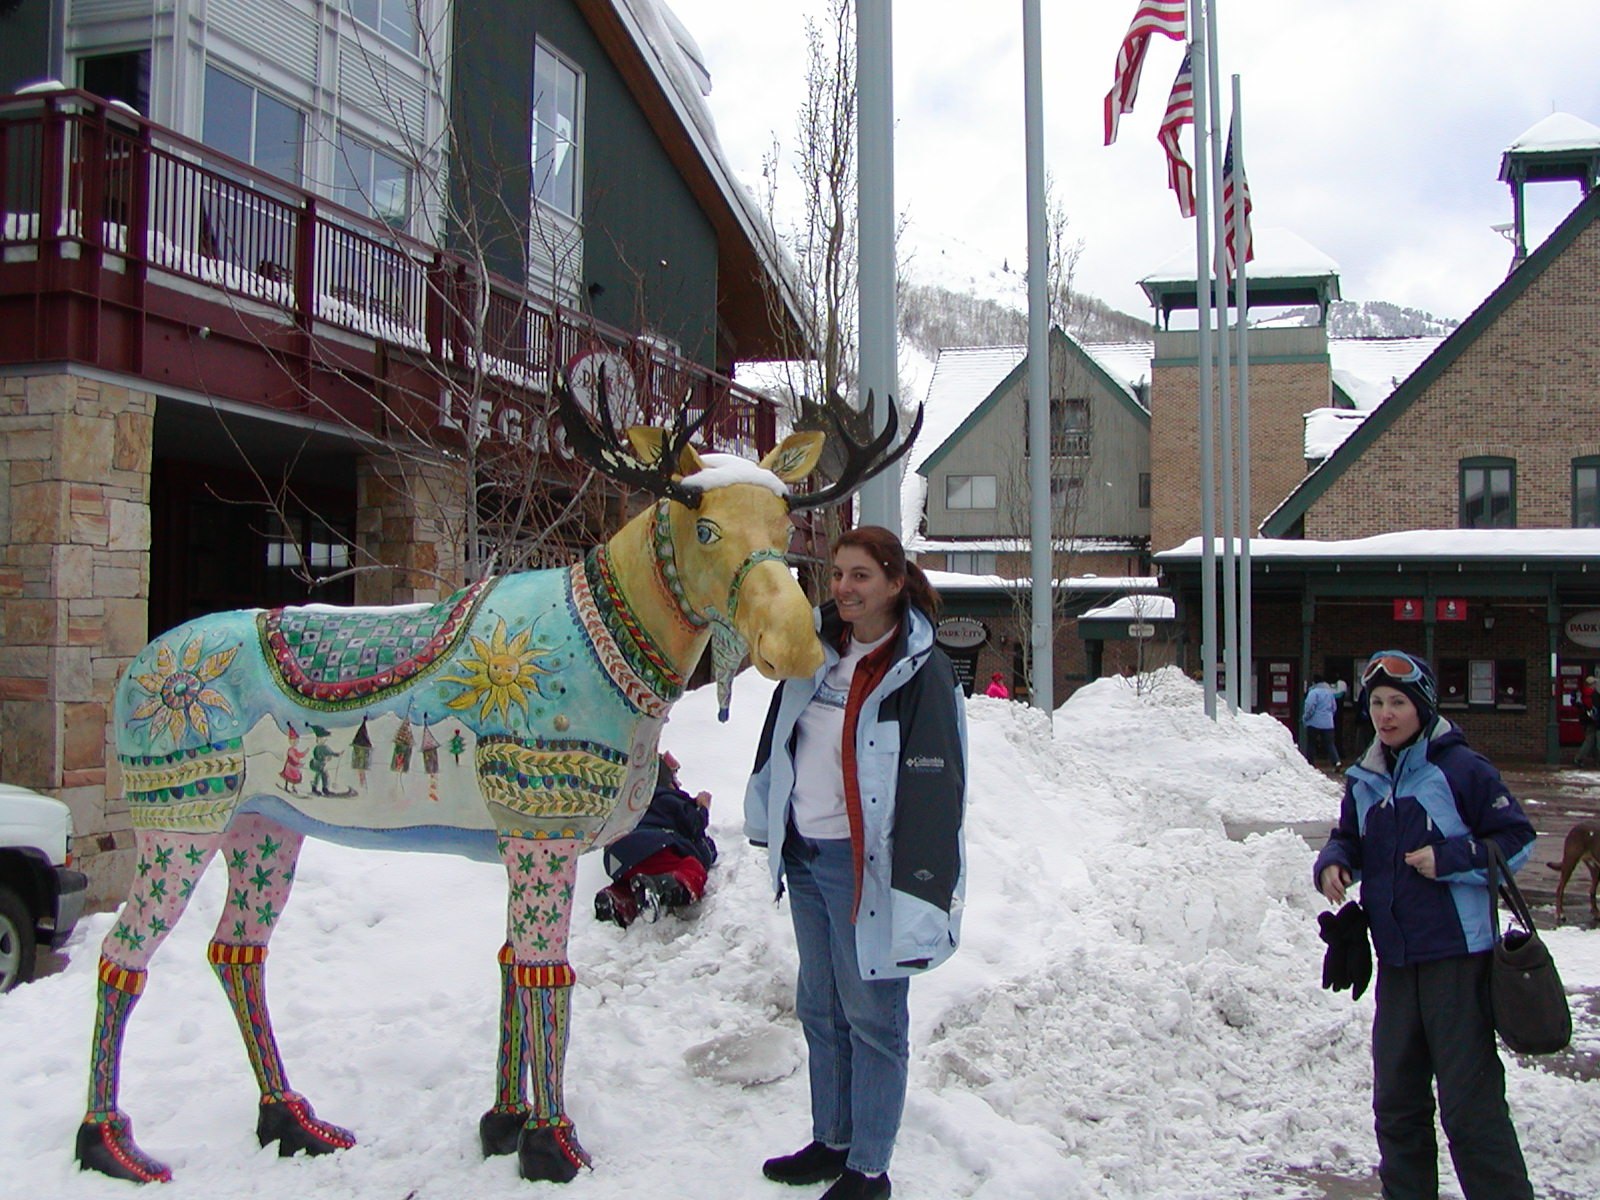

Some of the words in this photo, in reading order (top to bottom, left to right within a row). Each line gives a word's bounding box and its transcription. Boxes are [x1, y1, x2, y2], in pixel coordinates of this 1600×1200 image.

[1570, 623, 1598, 633] PARK
[964, 630, 982, 638] CITY
[914, 756, 944, 764] Columbia
